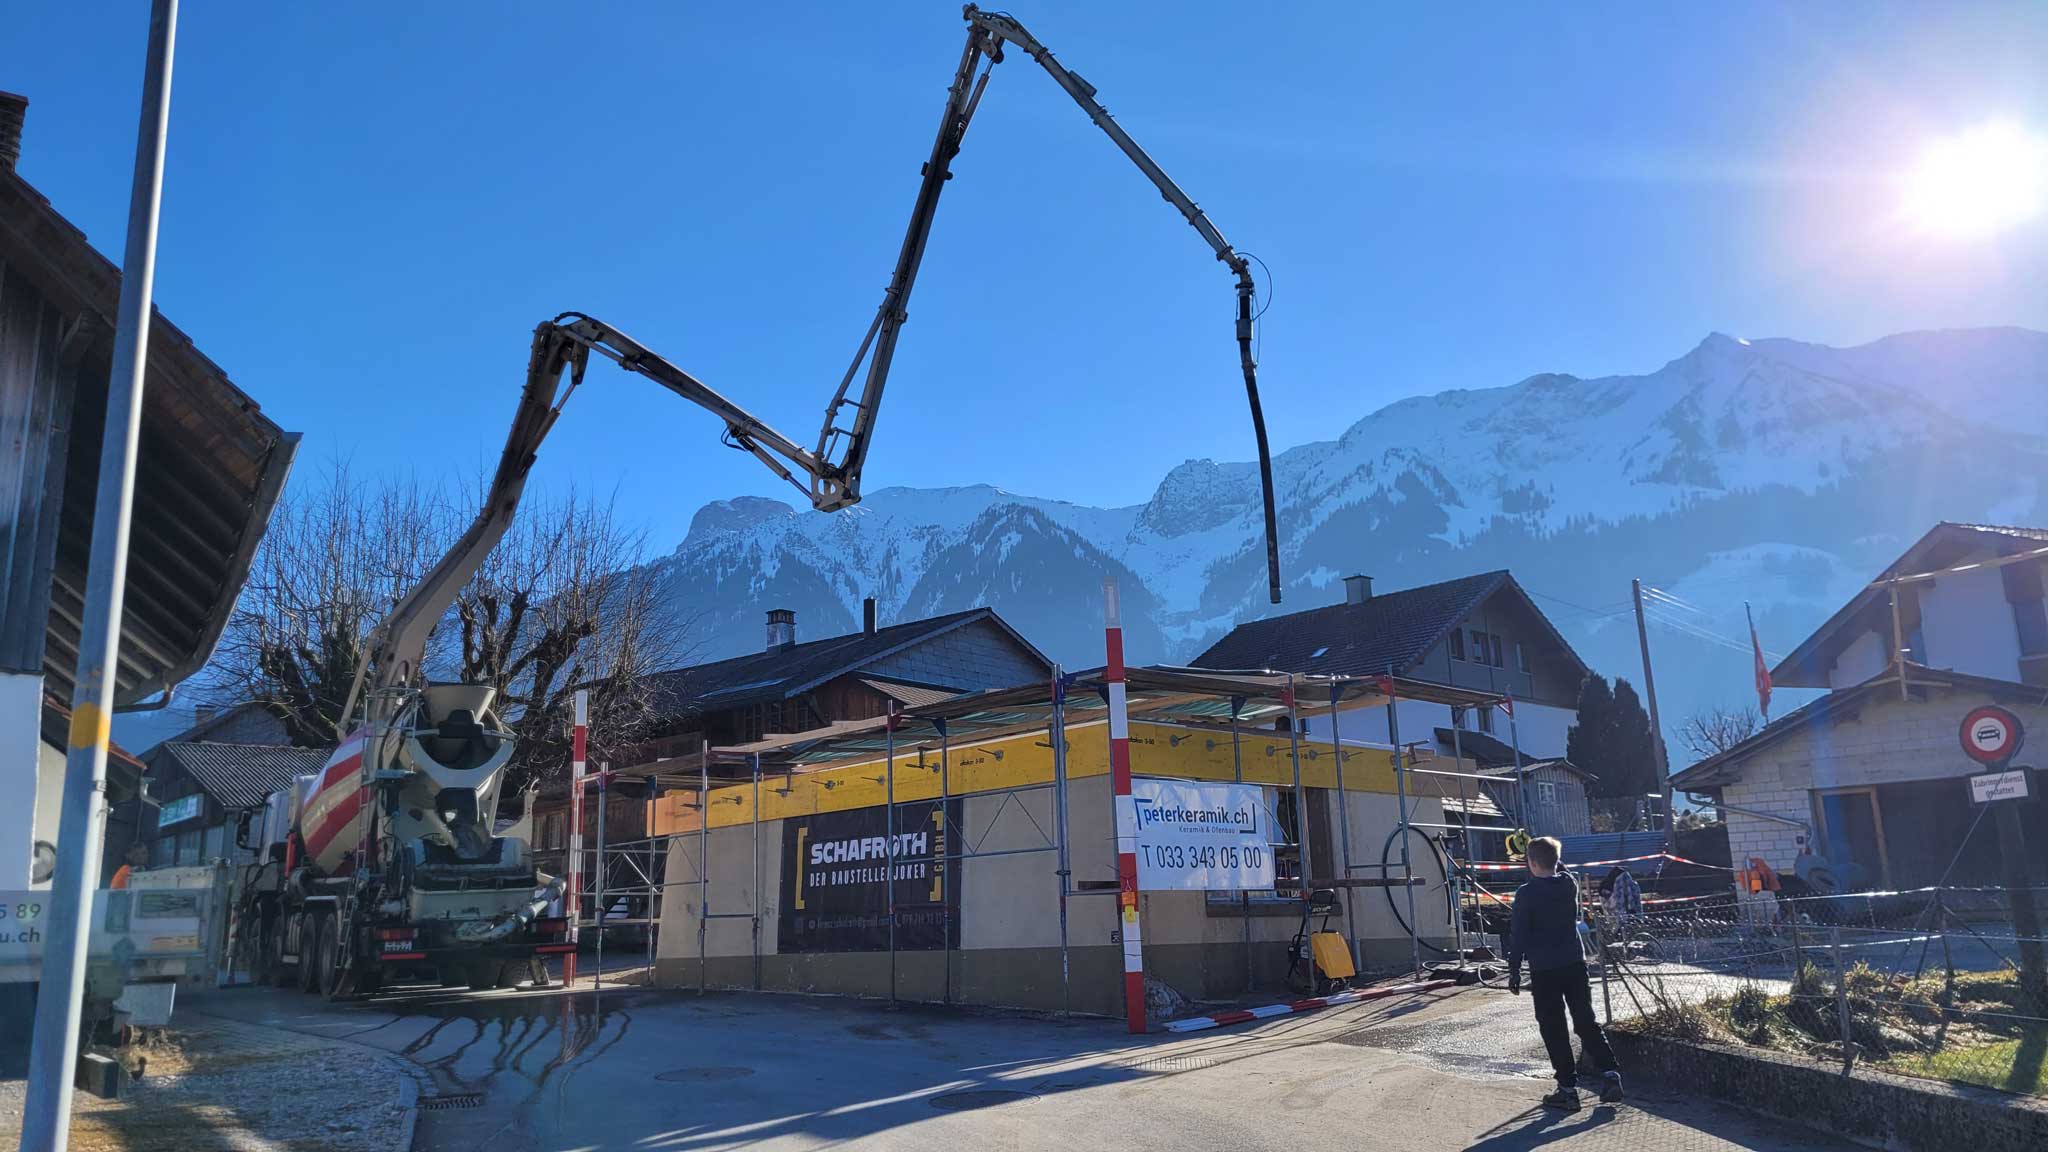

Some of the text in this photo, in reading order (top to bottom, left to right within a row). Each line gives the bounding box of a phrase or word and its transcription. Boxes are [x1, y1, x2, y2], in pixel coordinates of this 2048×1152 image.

[1143, 805, 1249, 825] peterkeramik.ch
[811, 832, 927, 865] SCHAFROTH
[1141, 845, 1262, 869] T 033 343 05 00
[810, 872, 826, 887] DER
[16, 903, 41, 919] 89
